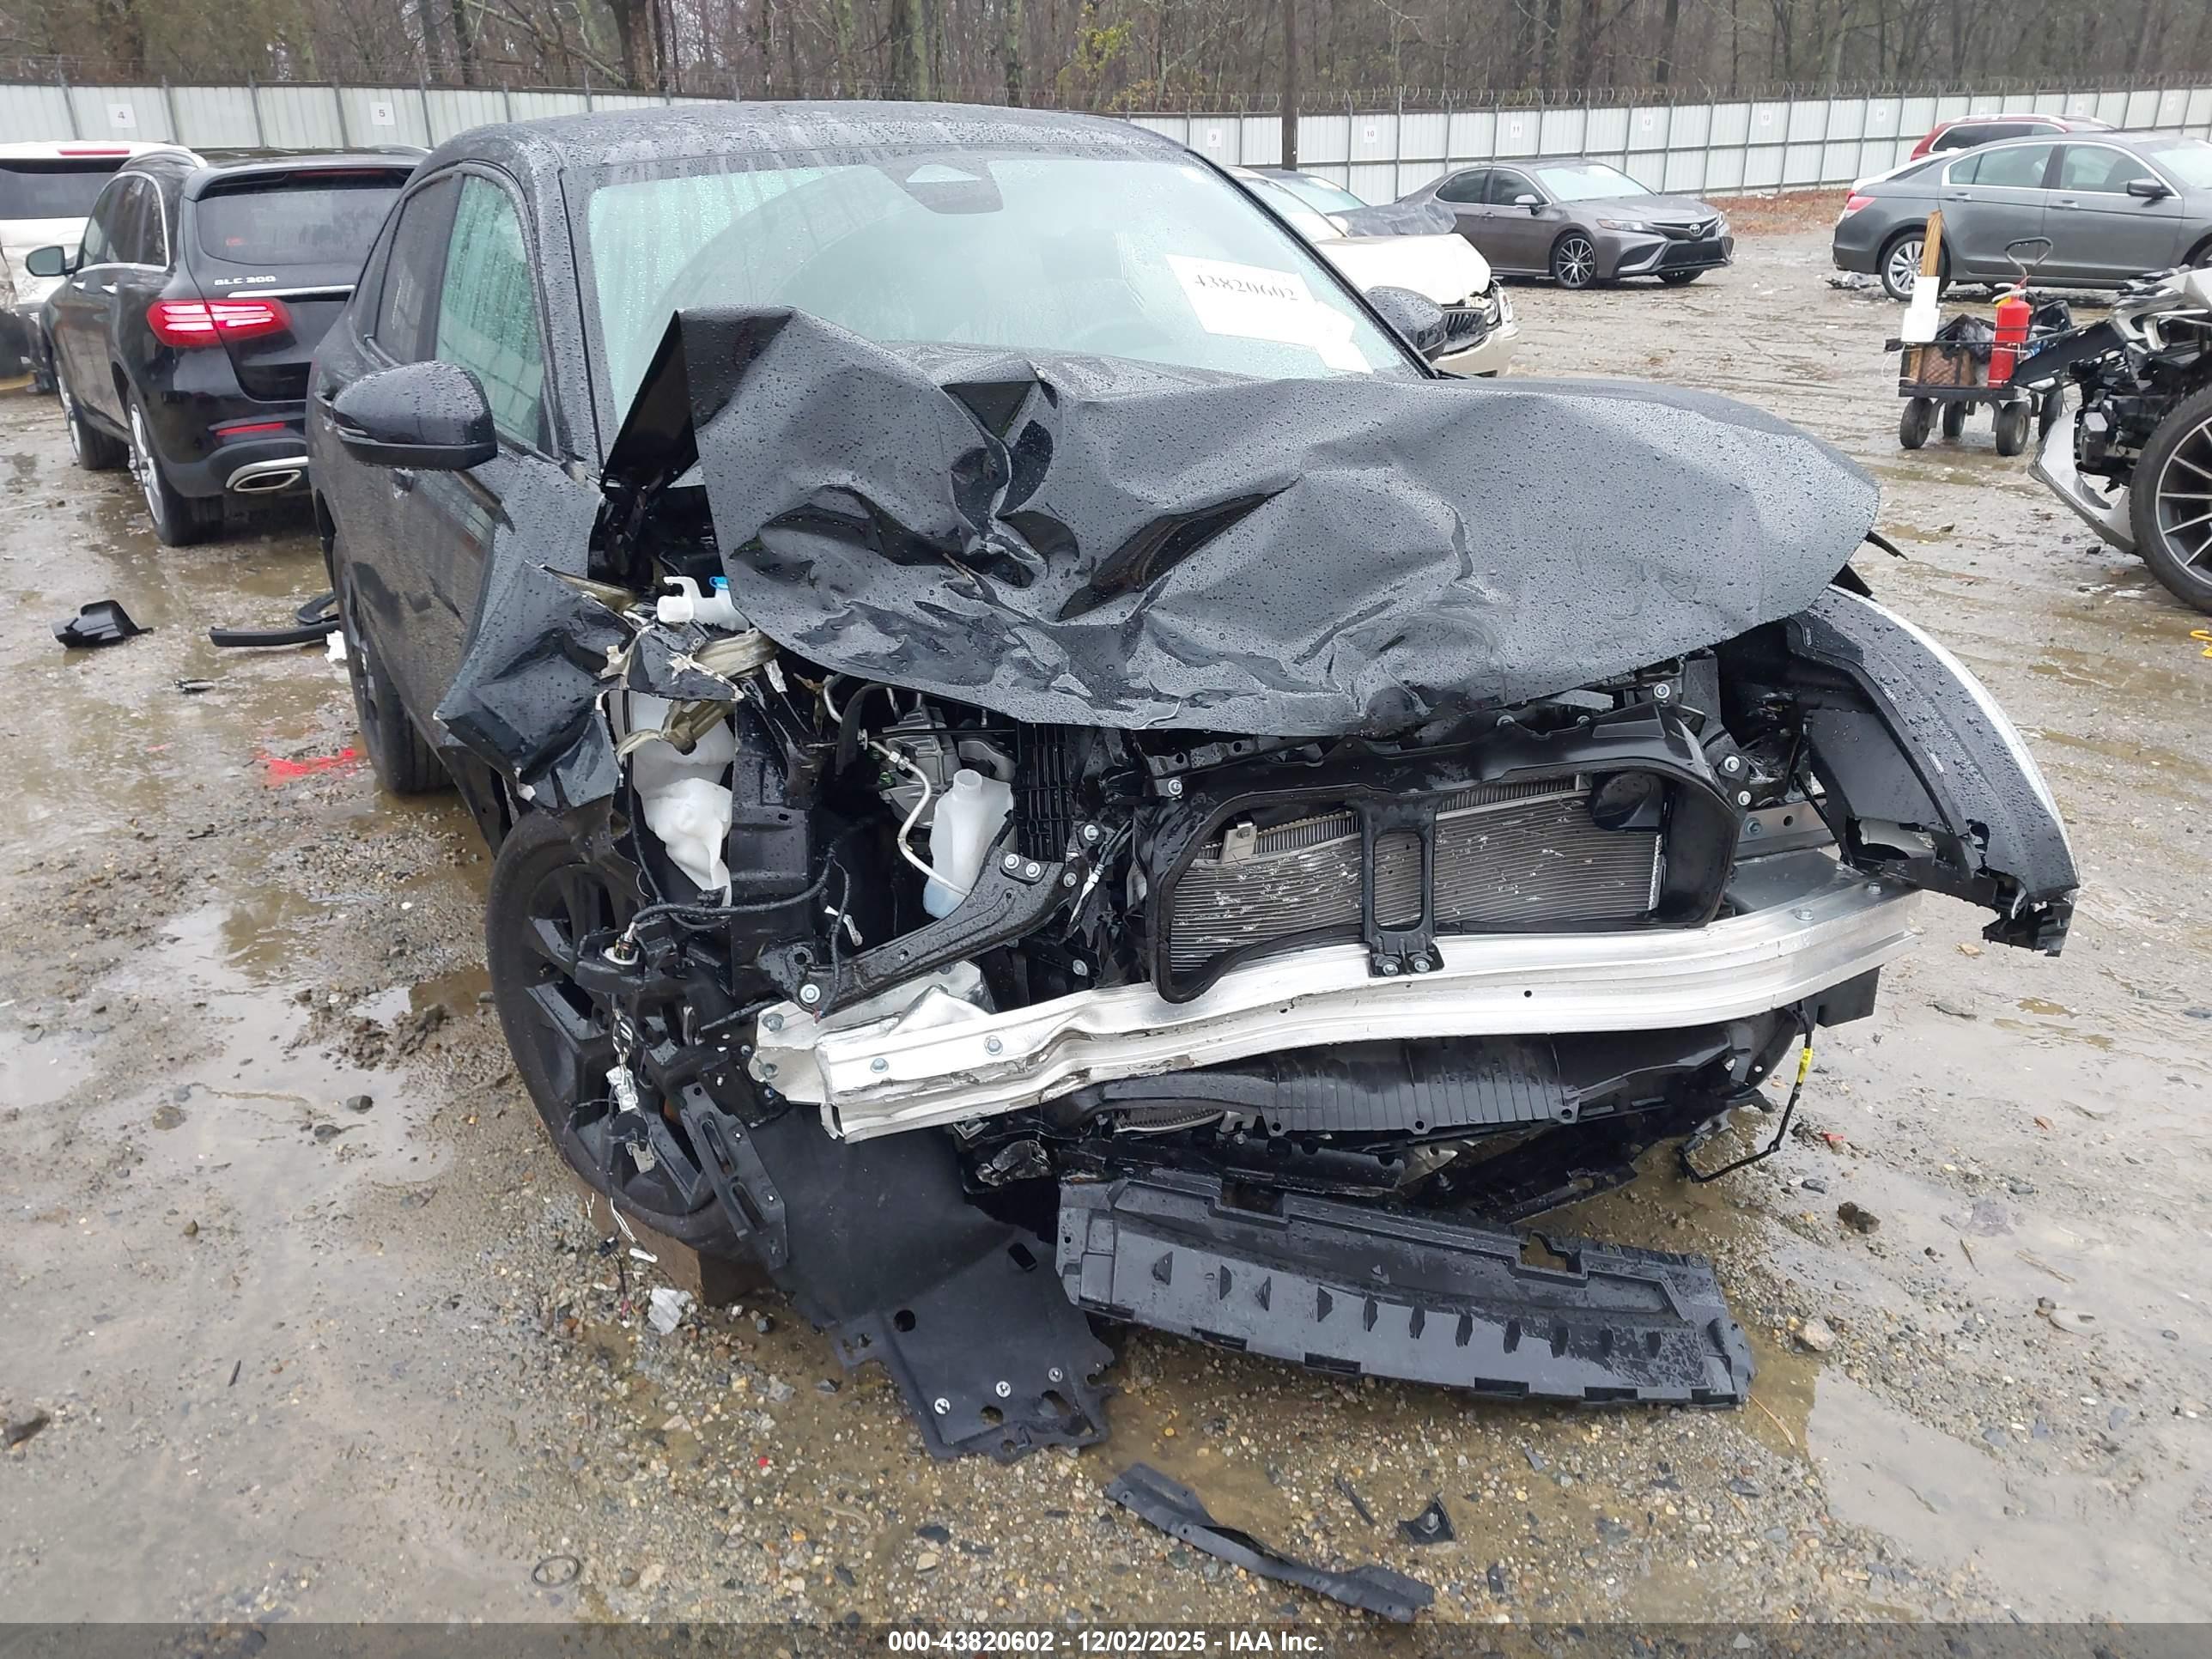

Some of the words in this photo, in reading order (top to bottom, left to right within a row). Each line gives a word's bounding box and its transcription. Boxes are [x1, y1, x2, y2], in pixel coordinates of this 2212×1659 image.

[118, 111, 126, 119] 4
[379, 109, 386, 118] 5
[1211, 133, 1217, 142] 9
[214, 277, 244, 286] GLC
[246, 275, 276, 283] 300
